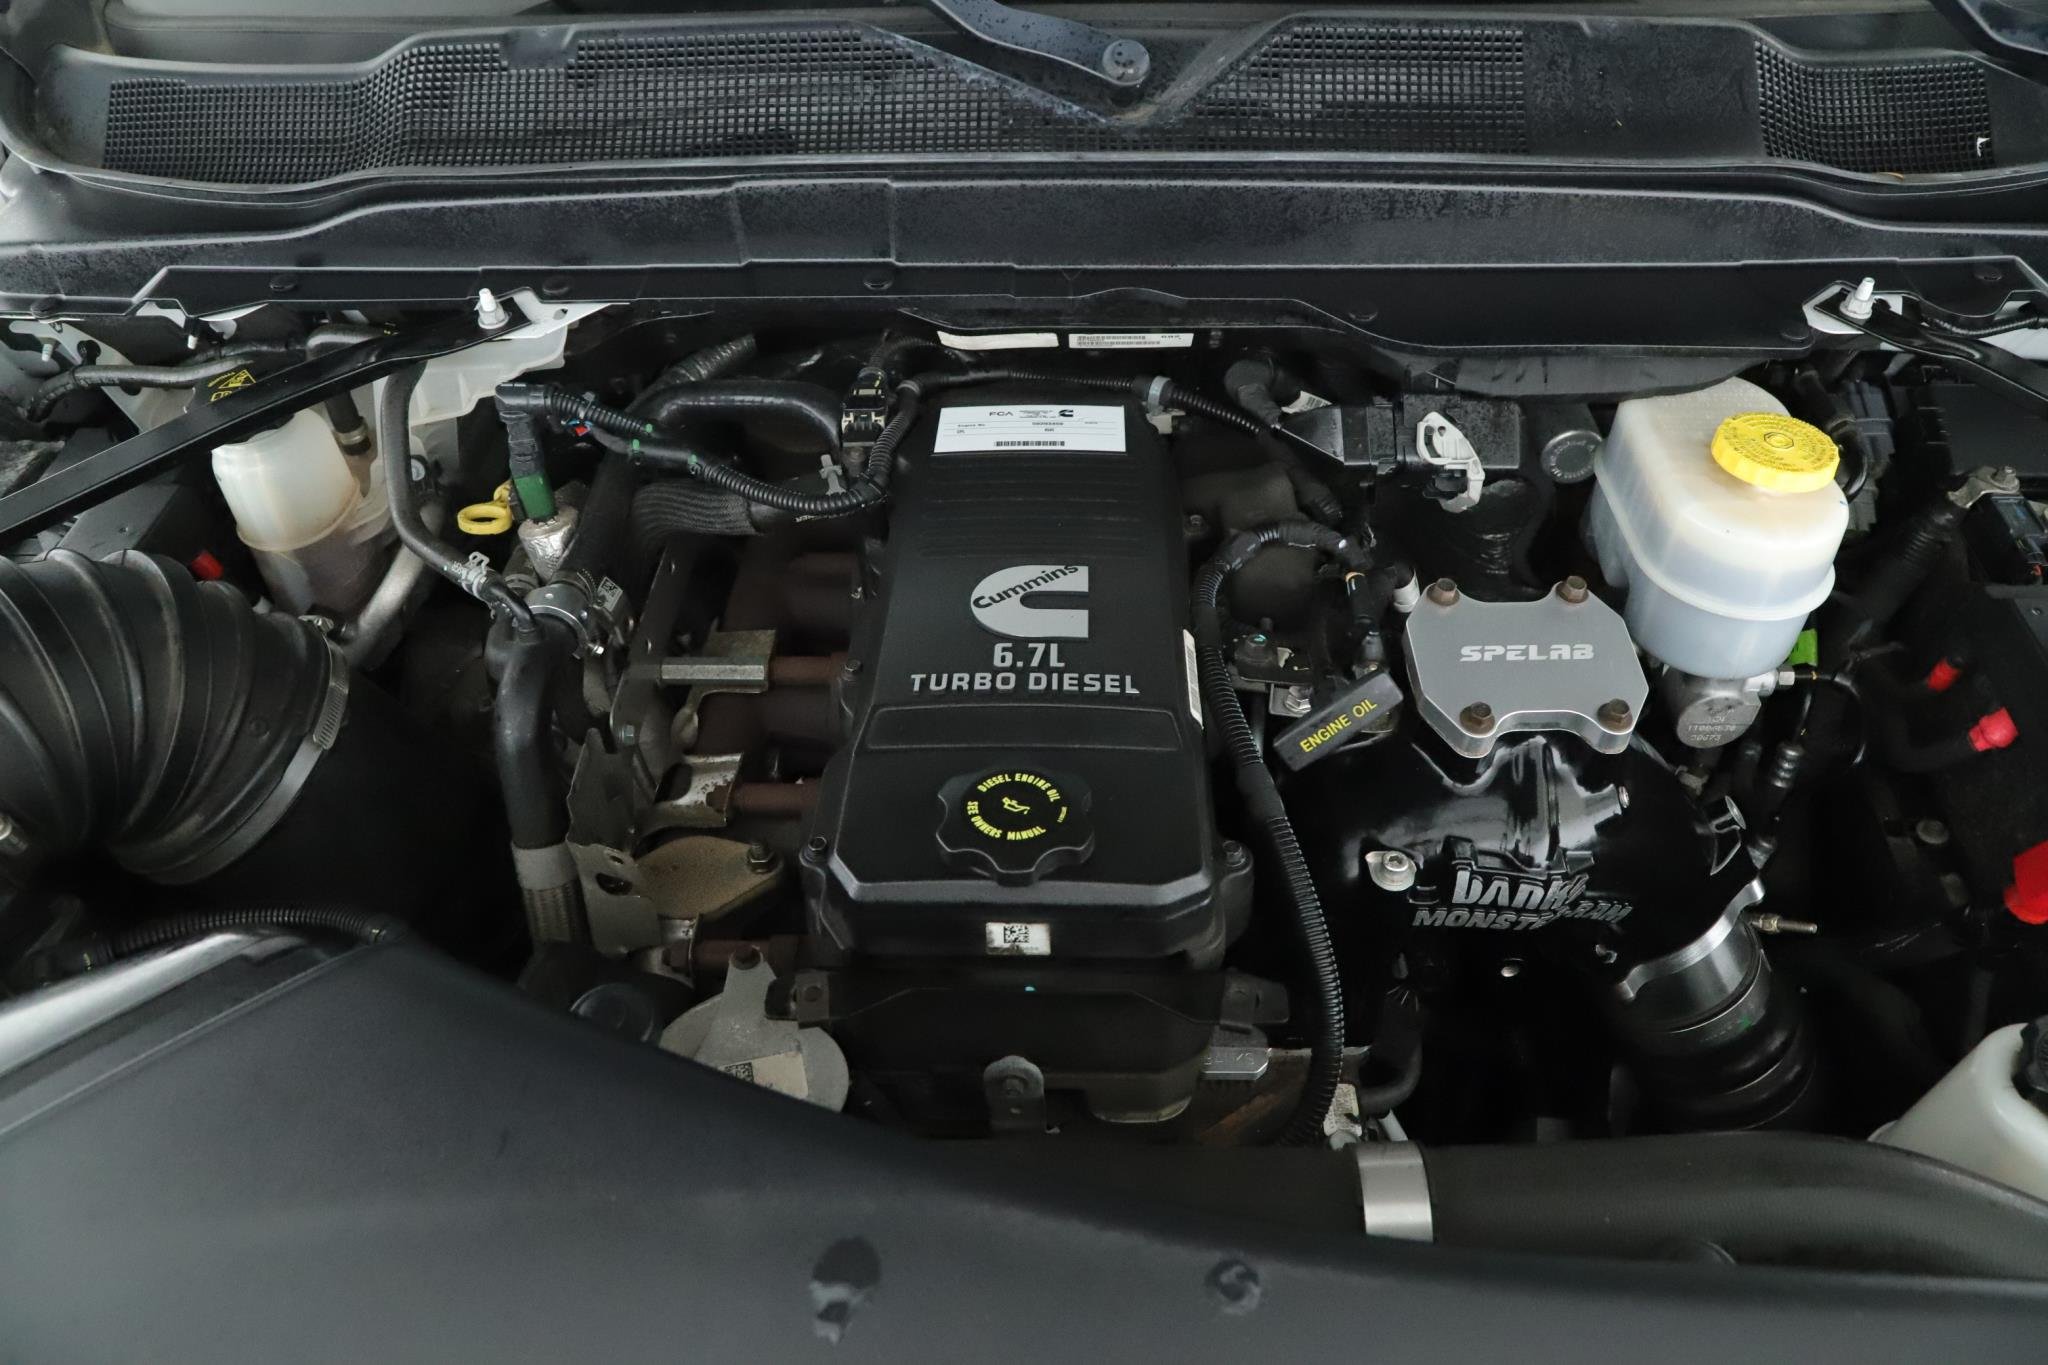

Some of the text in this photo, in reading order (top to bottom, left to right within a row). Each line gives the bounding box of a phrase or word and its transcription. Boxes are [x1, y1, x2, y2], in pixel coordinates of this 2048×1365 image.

[973, 565, 1079, 609] Cummins
[993, 642, 1065, 668] 6.7L
[1460, 643, 1594, 662] SPELAB
[911, 672, 1140, 694] TURBO DIESEL
[1300, 699, 1378, 752] ENGINE OIL
[977, 773, 1060, 802] DIESEL ENGINE OIL
[967, 801, 1046, 840] SEE OWNERS MANUAL
